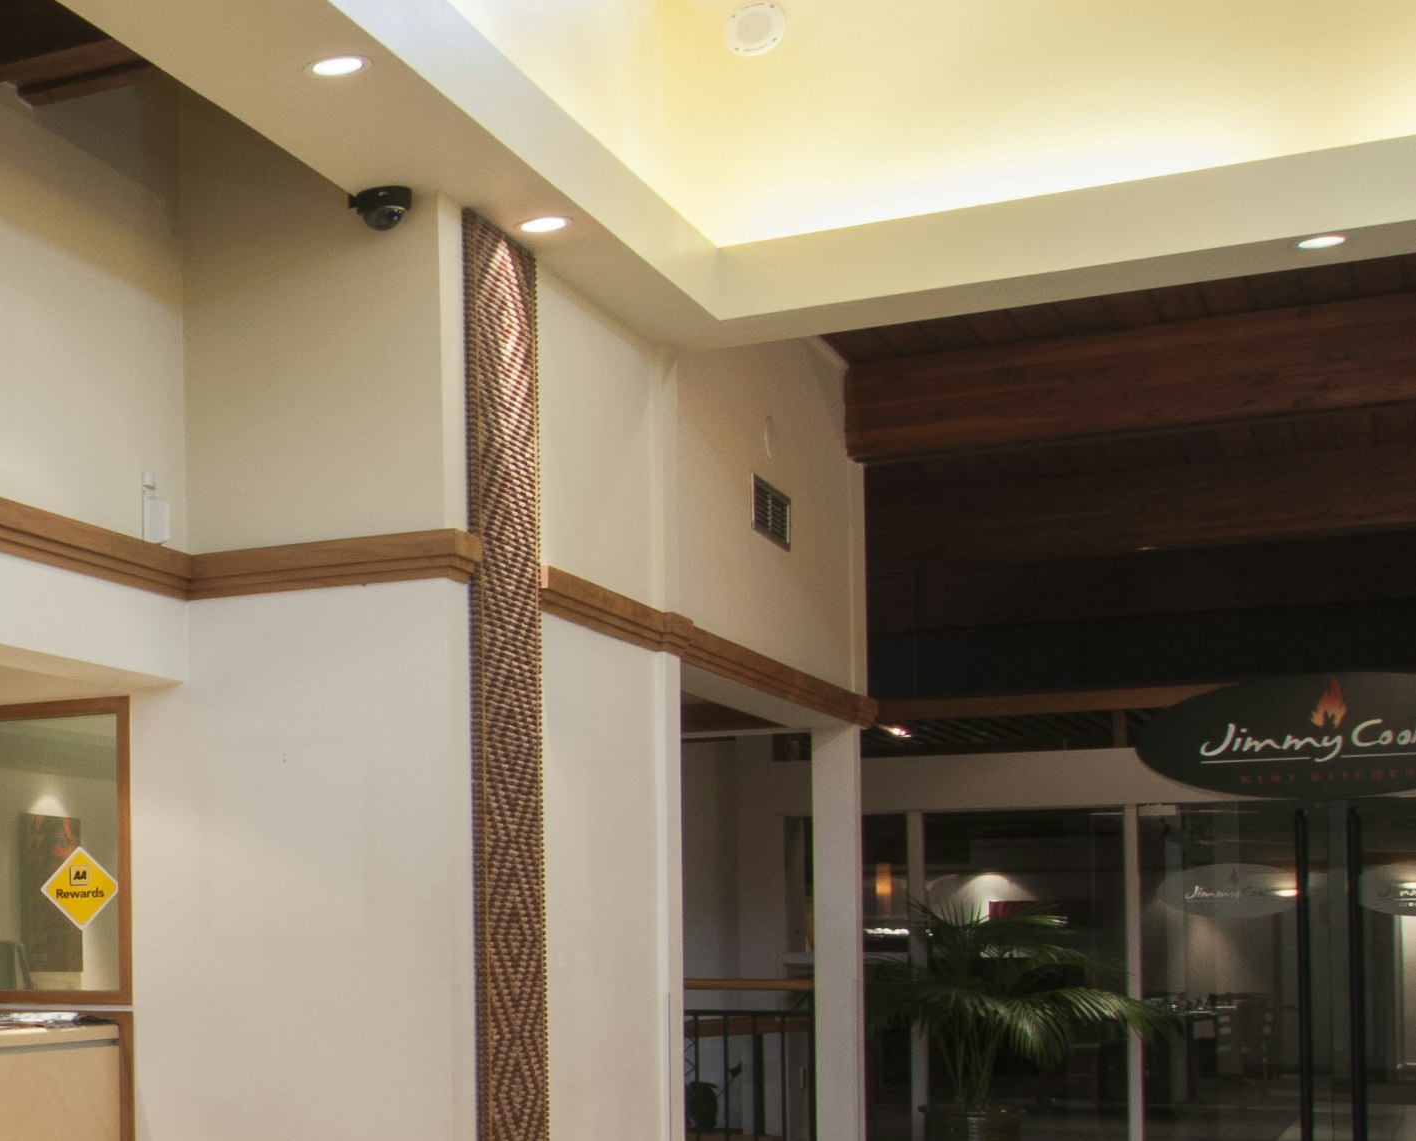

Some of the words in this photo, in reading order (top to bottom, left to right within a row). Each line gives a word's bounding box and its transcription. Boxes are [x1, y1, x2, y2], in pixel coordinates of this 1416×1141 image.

[1200, 723, 1342, 763] Jimmy
[1351, 718, 1416, 748] Coo
[1240, 773, 1295, 785] KIWI
[56, 887, 105, 899] Rewards
